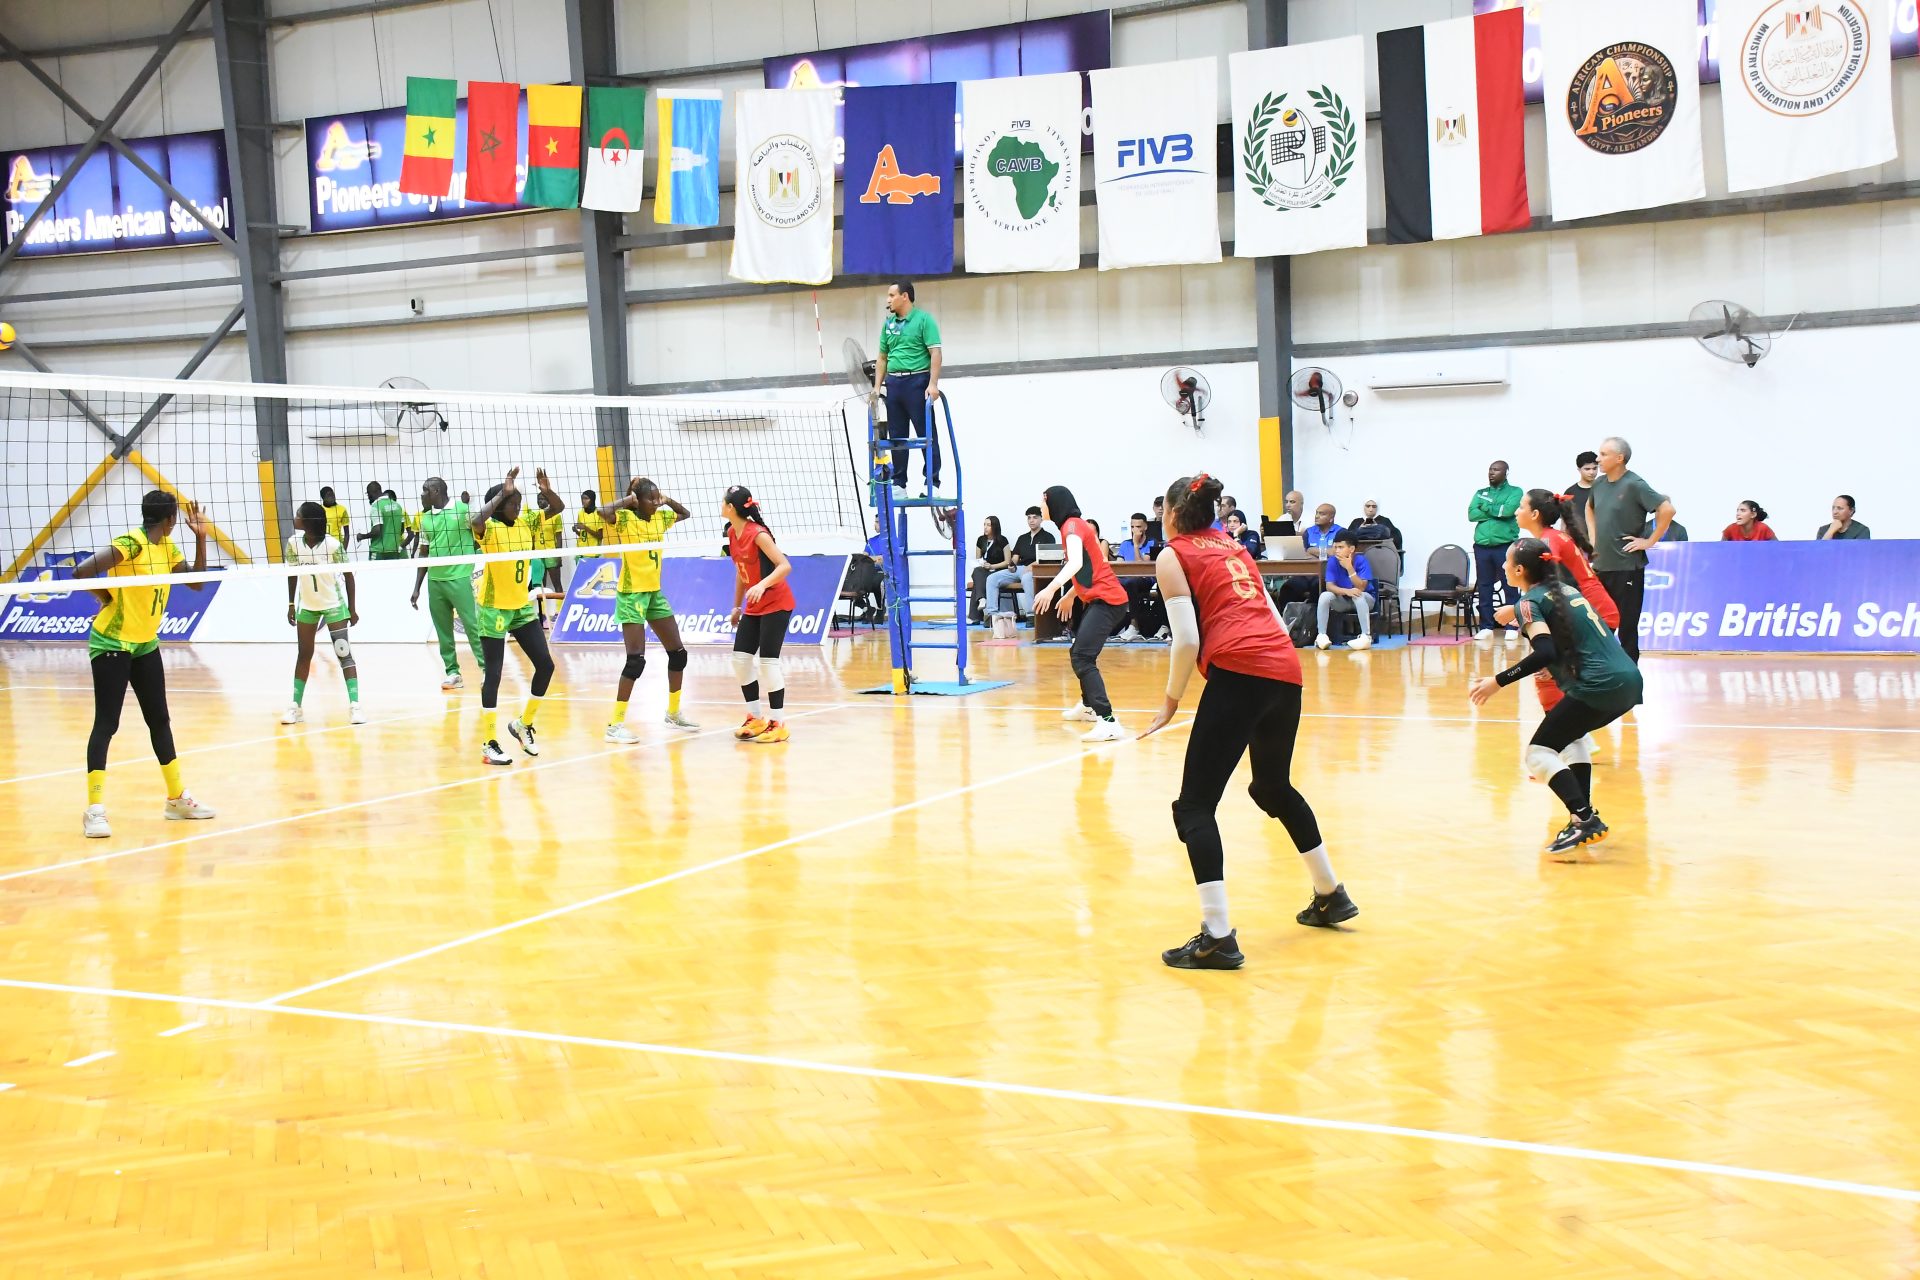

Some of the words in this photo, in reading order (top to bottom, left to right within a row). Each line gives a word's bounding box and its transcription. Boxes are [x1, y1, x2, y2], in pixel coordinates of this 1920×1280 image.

[1837, 4, 1863, 52] EDUCATION
[1748, 23, 1770, 69] MINISTRY
[1571, 51, 1604, 95] AFRICAN
[1606, 43, 1673, 78] CHAMPIONSHIP
[1749, 70, 1760, 82] OF
[1824, 53, 1861, 101] TECHNICAL
[1754, 81, 1800, 110] EDUCATION
[1802, 96, 1824, 109] AND
[1011, 119, 1031, 129] FIVB
[1600, 105, 1663, 131] Pioneers
[995, 156, 1043, 173] CAVB
[1117, 133, 1194, 168] FIVB
[315, 176, 402, 215] Pioneers
[5, 211, 82, 245] Pineers
[84, 205, 167, 240] American
[765, 212, 775, 221] OF
[774, 216, 797, 225] YOUTH
[796, 208, 810, 221] AND
[581, 530, 588, 543] 9
[515, 559, 525, 584] 8
[1225, 555, 1258, 600] 8
[151, 588, 164, 617] 14
[1569, 597, 1607, 637] 7
[0, 605, 94, 634] Princesses
[155, 611, 199, 634] hool
[495, 615, 505, 631] 8
[561, 603, 624, 633] Pione
[788, 608, 825, 634] ool
[1637, 609, 1710, 637] eers
[1718, 602, 1842, 637] British
[1853, 601, 1920, 638] Sch
